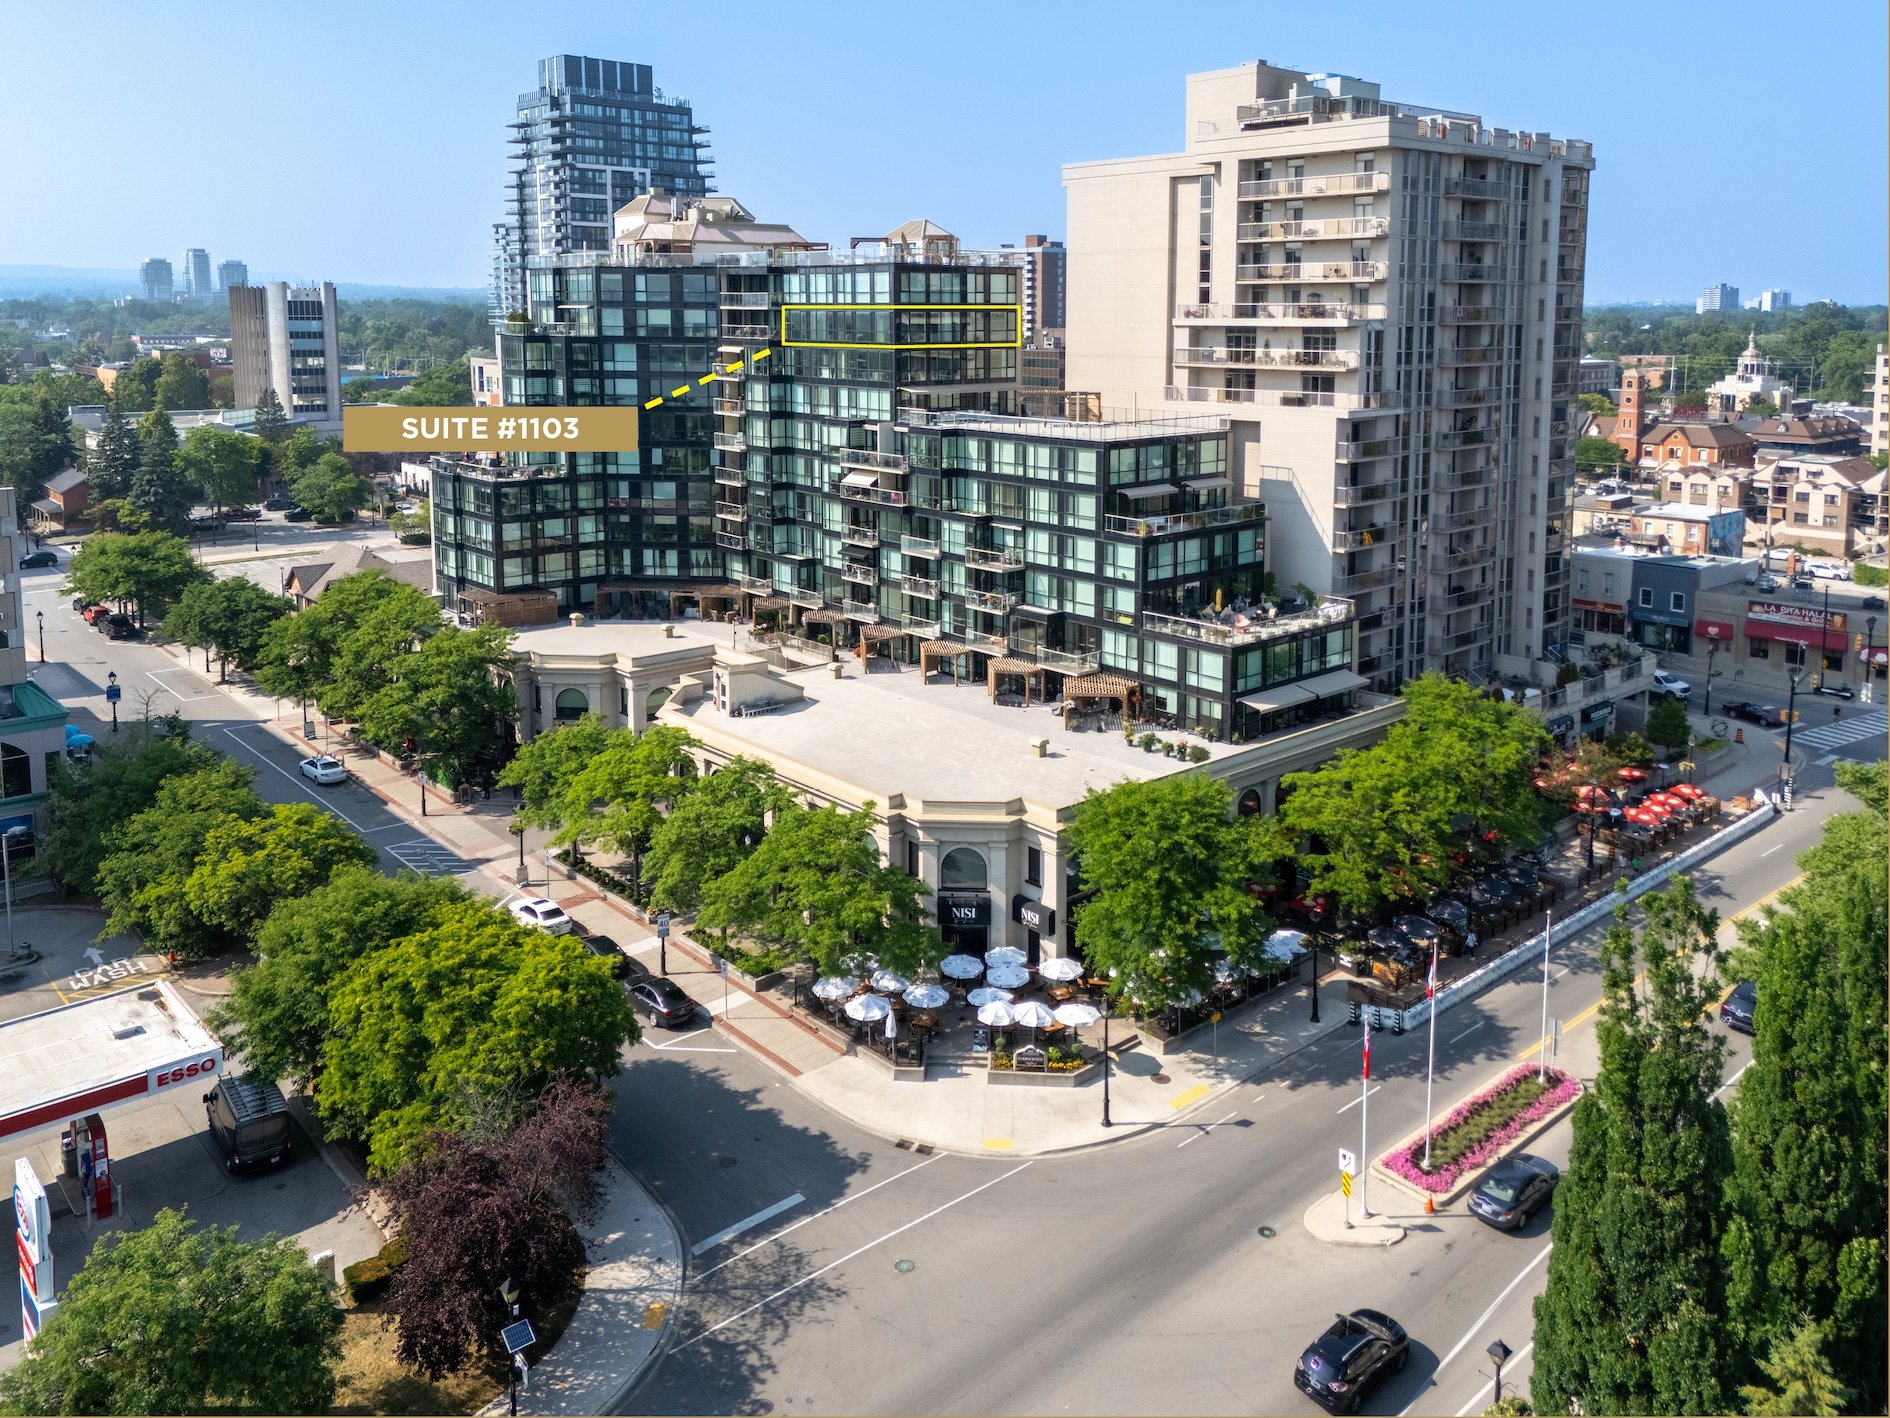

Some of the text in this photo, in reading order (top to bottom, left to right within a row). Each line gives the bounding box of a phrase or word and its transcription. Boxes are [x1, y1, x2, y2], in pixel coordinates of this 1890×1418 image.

[1764, 604, 1833, 620] LA PITA HALAL
[952, 907, 976, 919] NISI
[1021, 907, 1040, 925] NISI
[659, 920, 669, 928] 40
[69, 961, 148, 991] WASH
[74, 956, 131, 979] CAR
[156, 1057, 216, 1087] ESSO
